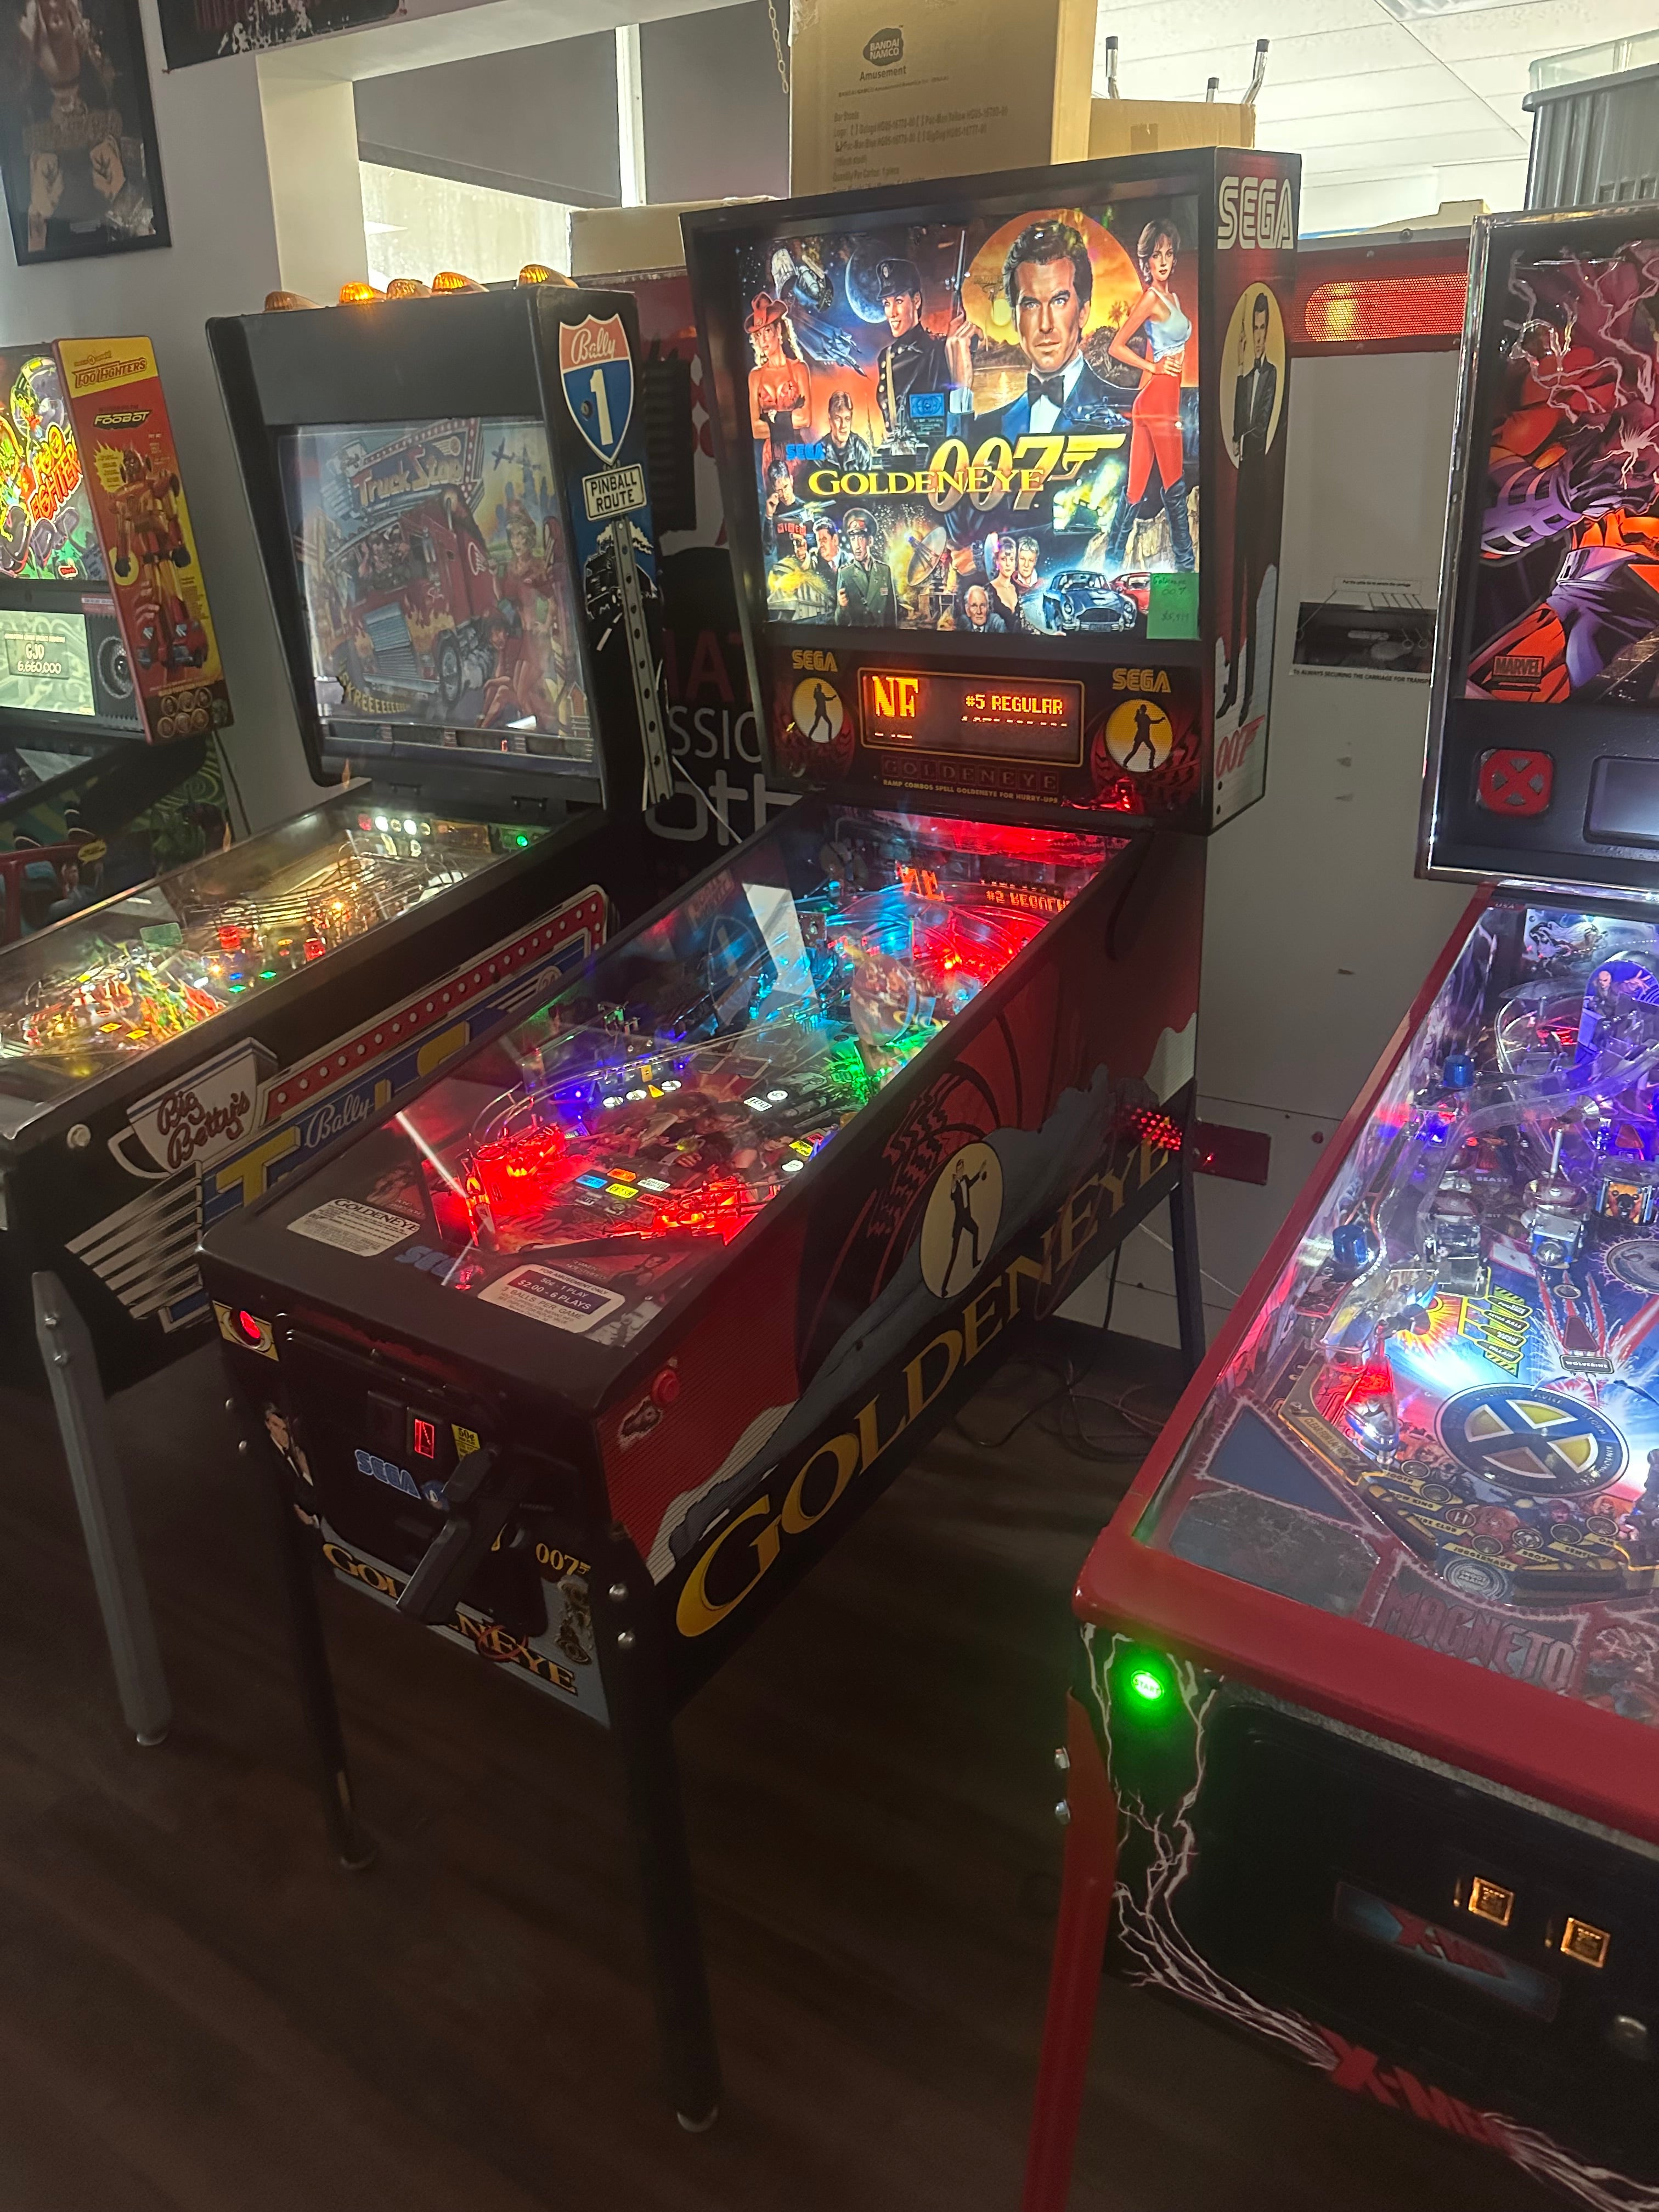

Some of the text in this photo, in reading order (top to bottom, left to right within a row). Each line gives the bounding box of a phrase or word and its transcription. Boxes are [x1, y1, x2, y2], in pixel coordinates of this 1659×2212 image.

[870, 38, 900, 51] BANDAI
[870, 47, 900, 60] NAMCO
[859, 65, 907, 82] Amusement
[1217, 176, 1294, 250] SEGA
[571, 327, 616, 364] Bally
[94, 410, 151, 425] FOOBOT
[590, 369, 614, 445] 1
[786, 443, 826, 461] SEGA
[351, 444, 463, 507] Truck Stop
[590, 471, 638, 496] PINBALL
[808, 466, 1044, 495] GOLDENEYE
[928, 435, 1065, 512] 007
[596, 489, 636, 512] ROUTE
[25, 643, 44, 660] GJD
[792, 650, 838, 672] SEGA
[1365, 674, 1392, 682] CARRIAGE
[1496, 658, 1539, 676] MARVEL
[1112, 668, 1172, 693] SEGA
[966, 694, 1063, 715] #5 REGULAR
[883, 759, 1057, 789] GOLDENEYE
[883, 779, 1058, 804] RAMP COMBOS SPELL GOLDENEYE FOR HURRY-UPS
[157, 1090, 206, 1135] Big
[303, 1097, 374, 1148] Bally
[167, 1090, 251, 1169] Betty's
[334, 1198, 419, 1231] GOLDENEYE
[394, 1245, 475, 1285] SEG
[517, 1279, 544, 1293] $2.00
[557, 1294, 592, 1311] PLAYS
[554, 1272, 592, 1289] AMUSEMENT
[591, 1286, 609, 1296] ONLY
[566, 1287, 589, 1299] PLAY
[509, 1289, 536, 1304] BALLS
[538, 1300, 556, 1311] PER
[558, 1307, 584, 1321] GAME
[1488, 1345, 1515, 1358] VILLAIN
[676, 1115, 1170, 1637] GOLDENEYE
[1565, 1360, 1609, 1369] WOLVERINE
[458, 1427, 475, 1441] 50¢
[1581, 1412, 1607, 1436] STORM
[354, 1449, 421, 1500] SEGA
[1412, 1498, 1434, 1509] KING
[535, 1542, 580, 1576] 007
[1454, 1546, 1512, 1570] JUGGERNAUT
[1373, 1581, 1577, 1692] MAGNETO
[1134, 1679, 1160, 1695] START
